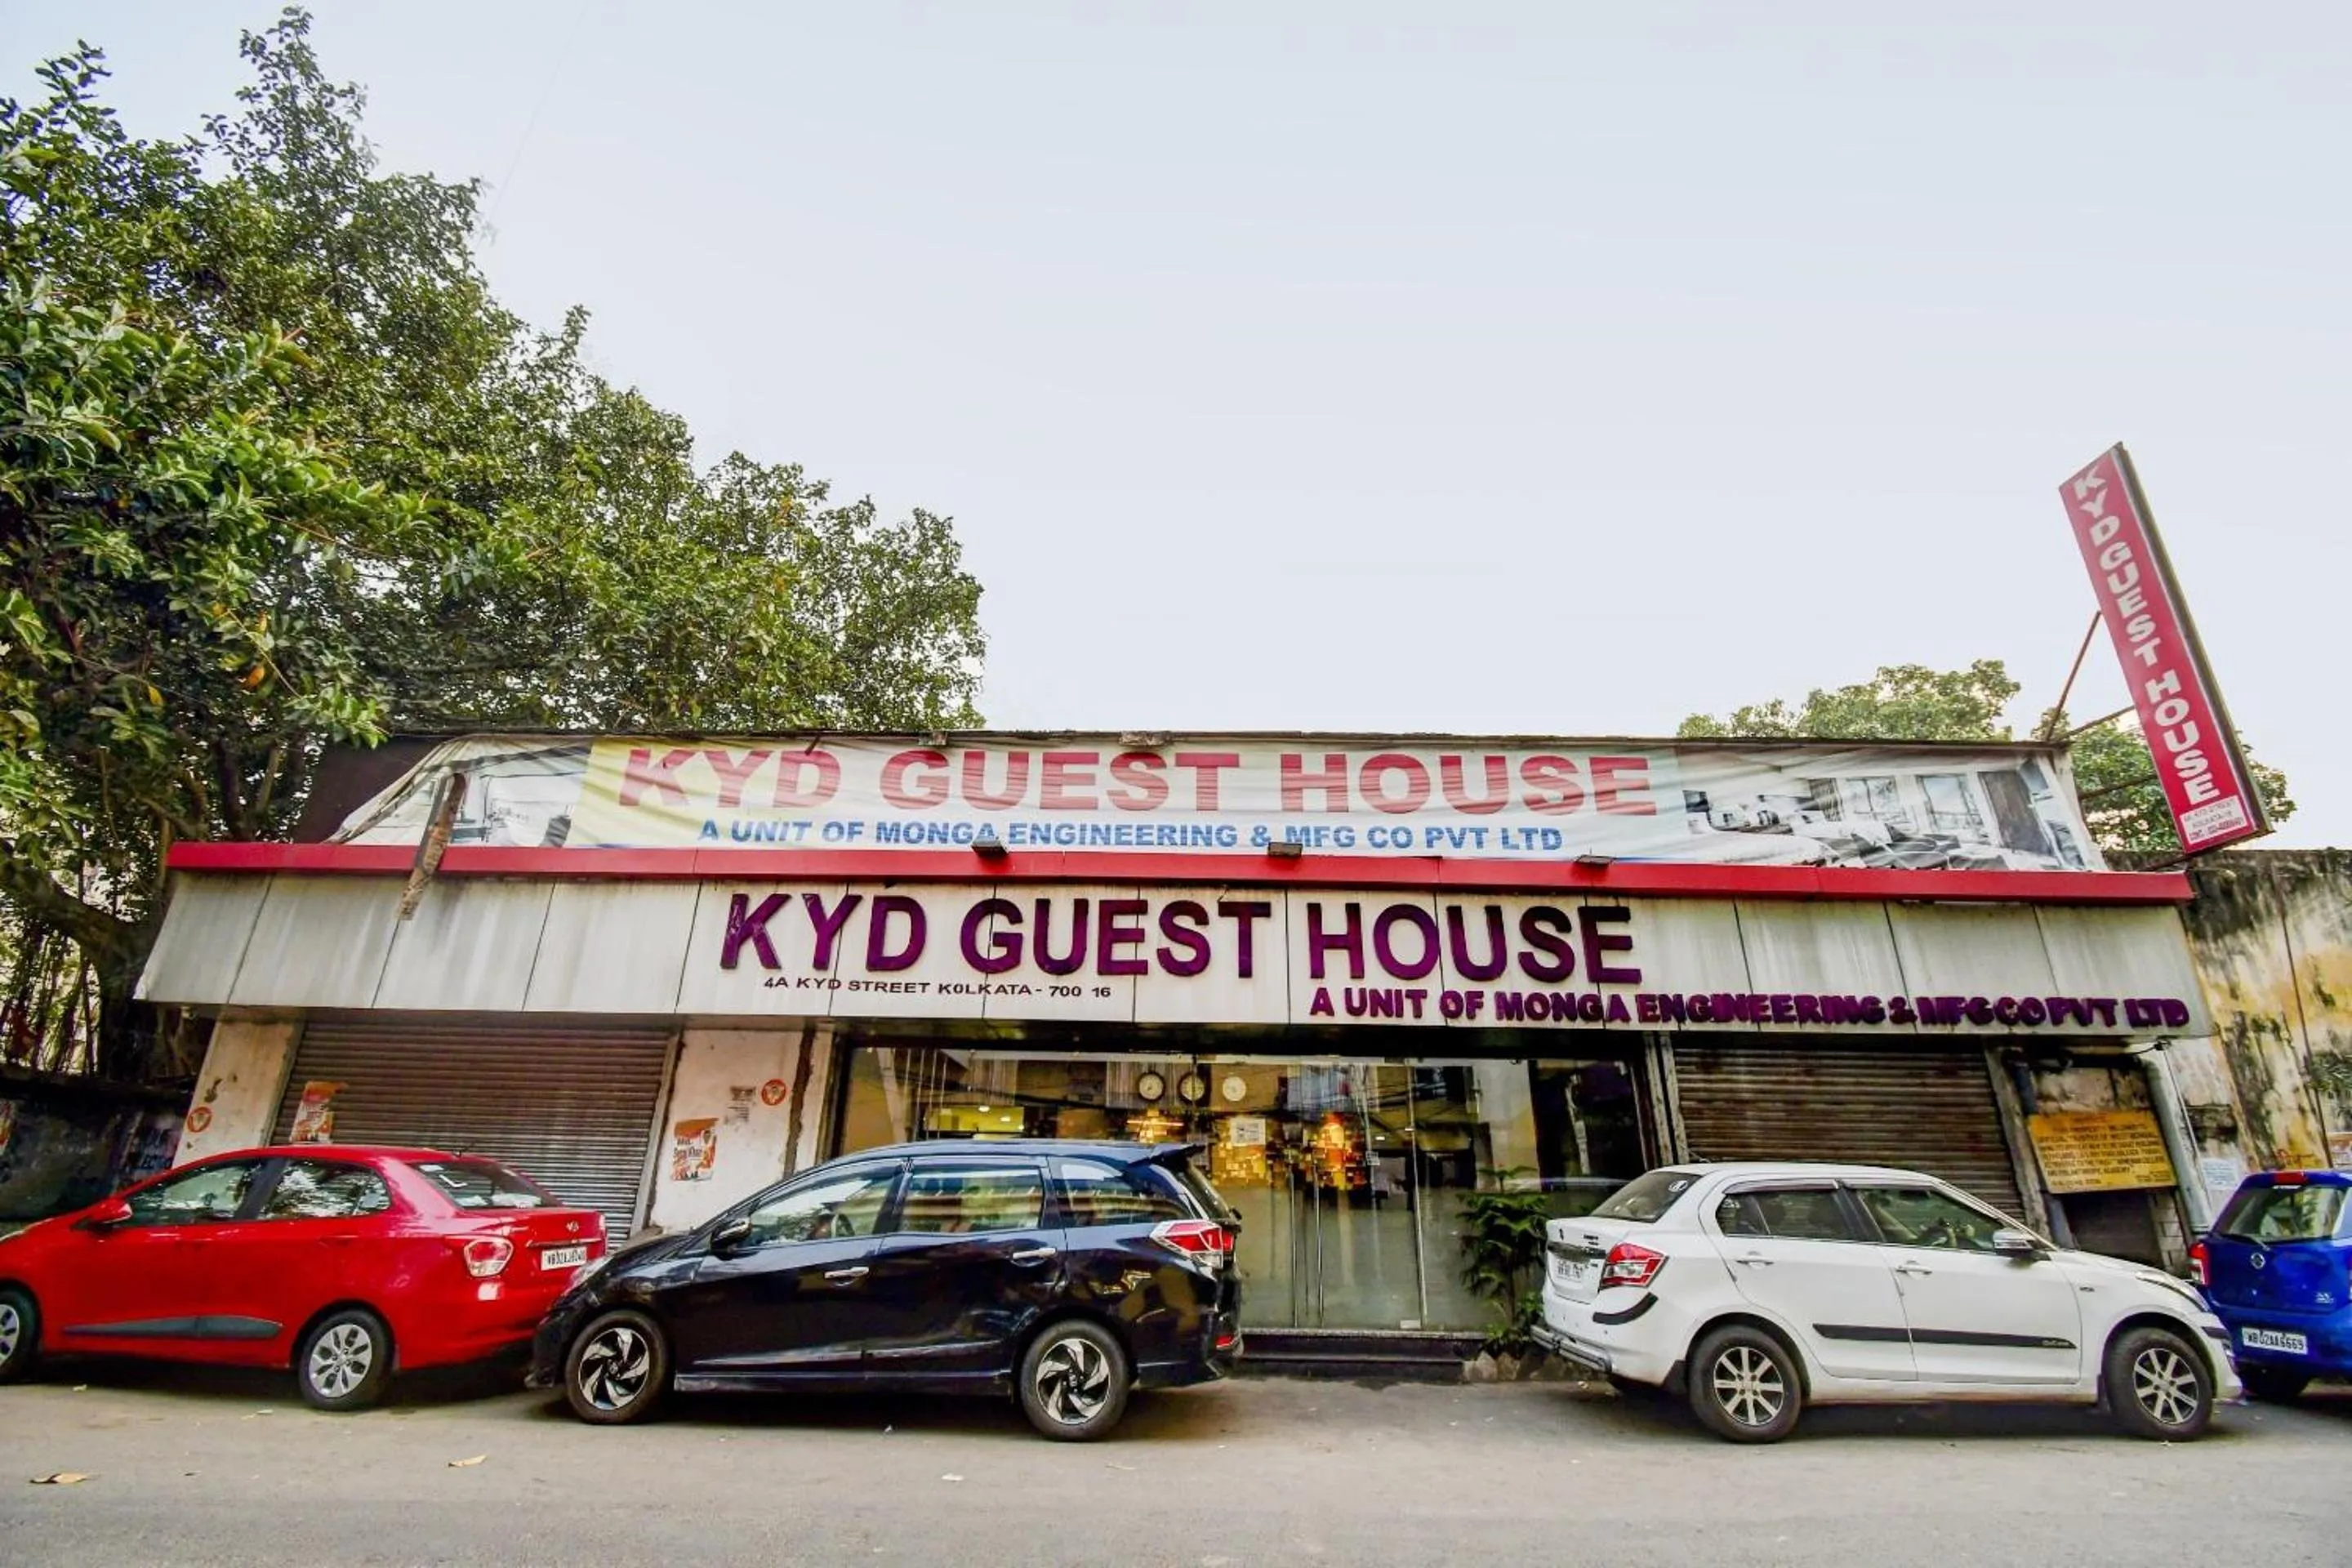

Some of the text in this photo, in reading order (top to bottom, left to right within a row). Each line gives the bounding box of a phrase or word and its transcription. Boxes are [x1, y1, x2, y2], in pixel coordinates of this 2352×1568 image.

[2074, 464, 2120, 547] KYD
[2100, 541, 2163, 667] GUEST
[2145, 669, 2221, 805] HOUSE
[618, 747, 1657, 816] KYD GUEST HOUSE
[698, 819, 1563, 852] A UNIT OF MONGA ENGINEERING & MFG CO PVT LTD
[719, 893, 1642, 985] KYD GUEST HOUSE
[764, 978, 789, 988] 4A
[796, 978, 841, 991] KYD
[848, 981, 930, 994] STREET
[1049, 986, 1082, 997] 700
[1092, 987, 1111, 998] 16
[1310, 987, 2190, 1028] A UNIT OF MONGA ENGINEERING & MFG CO PVT LTD
